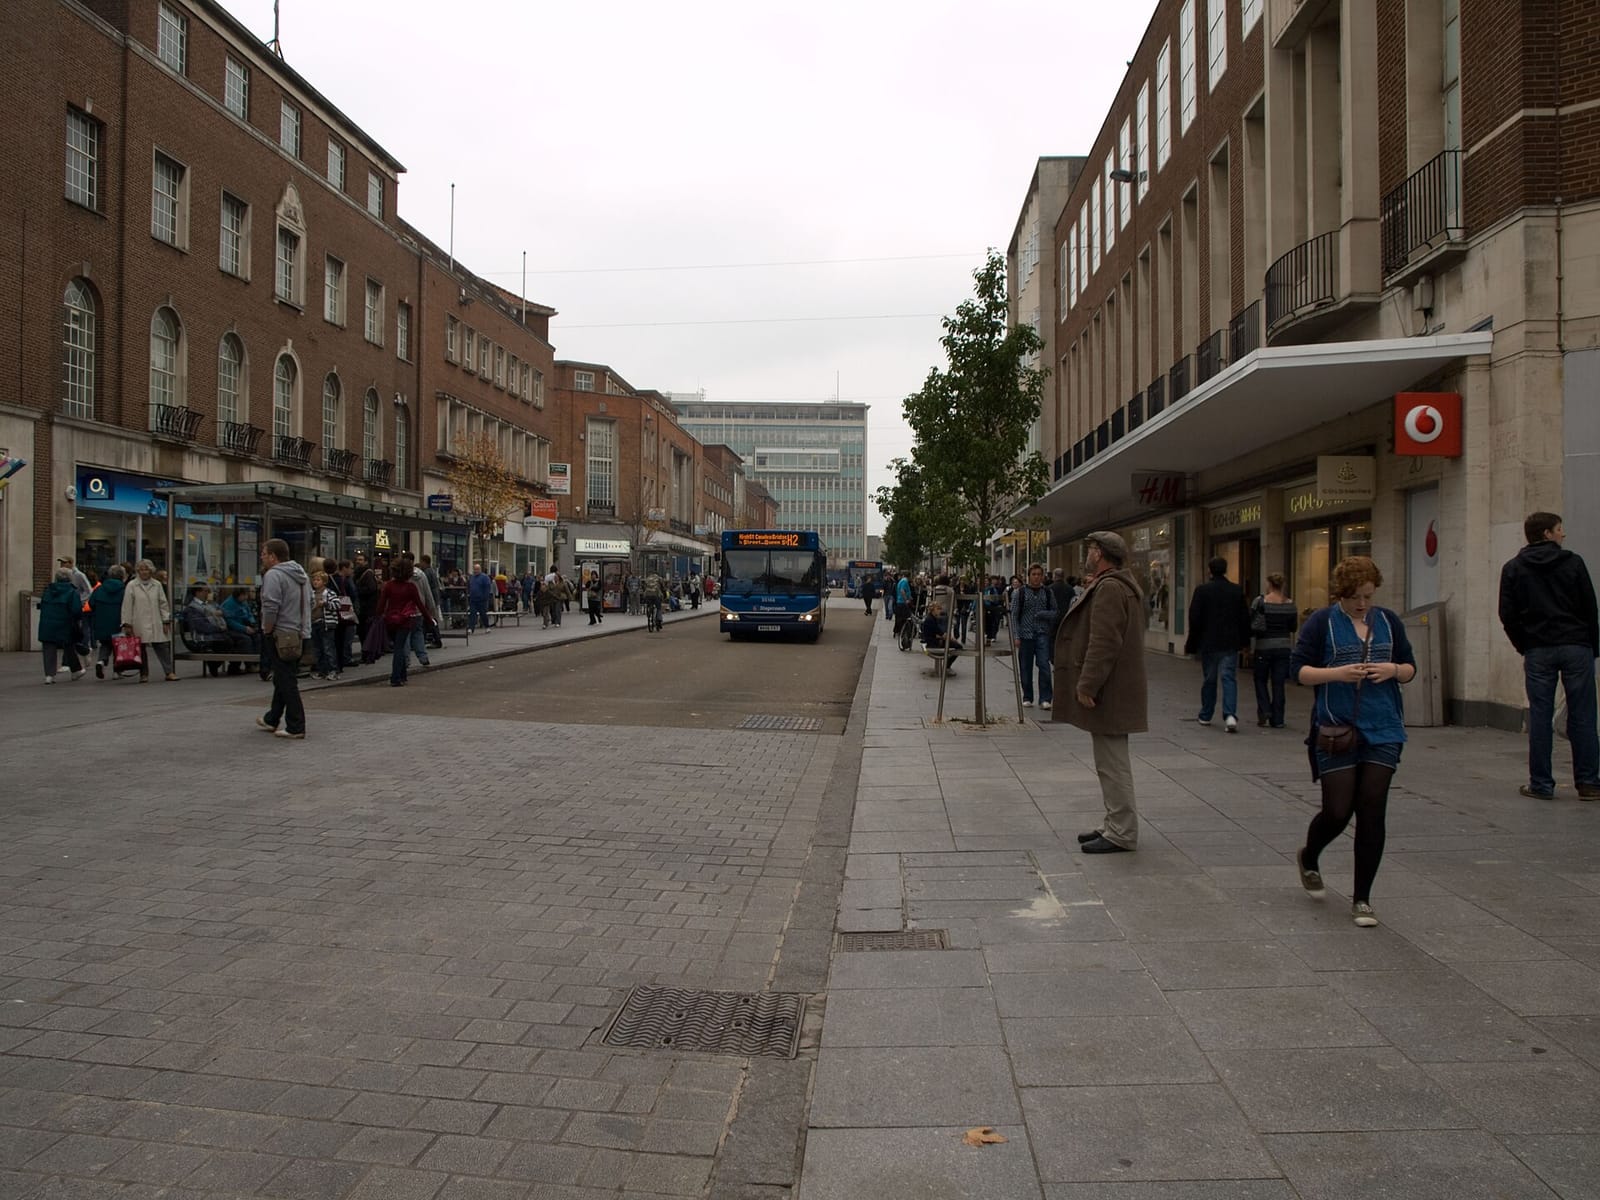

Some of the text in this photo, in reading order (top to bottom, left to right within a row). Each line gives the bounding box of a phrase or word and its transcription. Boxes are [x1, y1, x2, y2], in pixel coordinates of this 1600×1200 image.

[89, 477, 106, 496] O2
[1138, 477, 1179, 504] H&M
[585, 541, 608, 549] CALENDAR
[787, 534, 799, 546] H2
